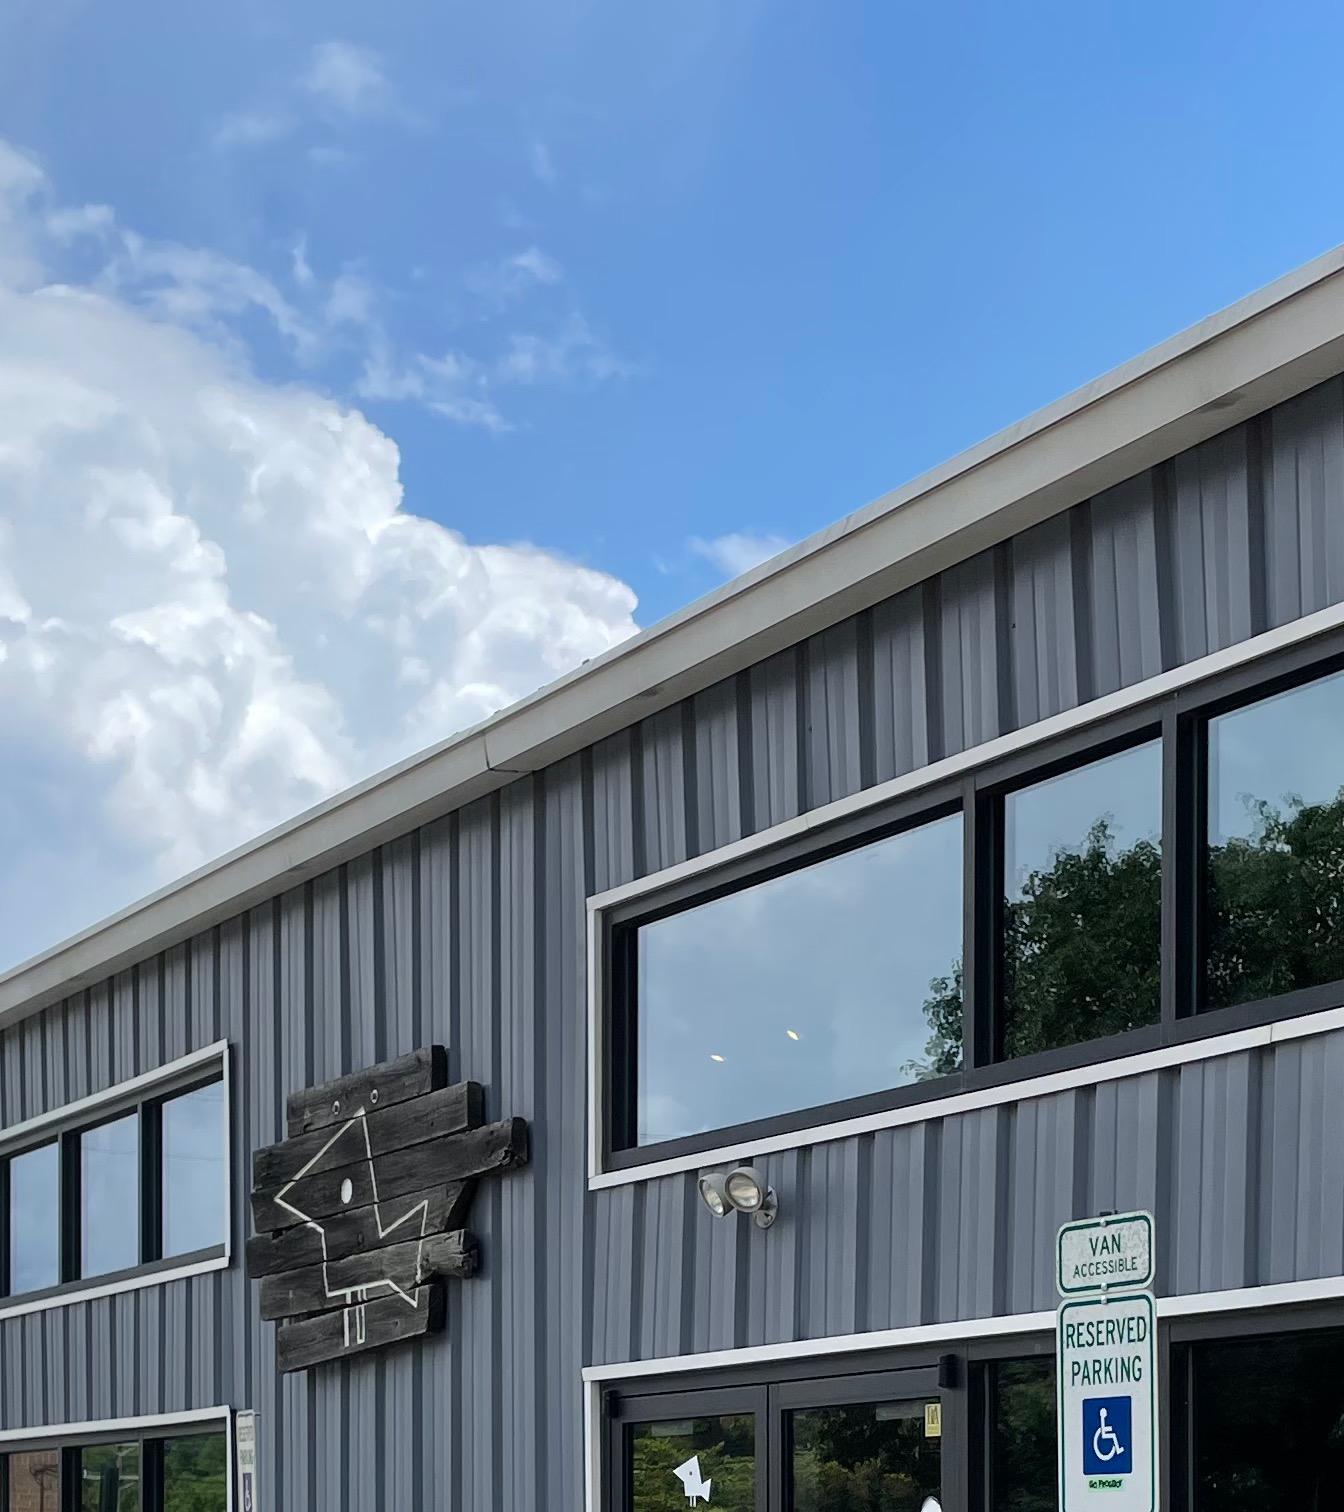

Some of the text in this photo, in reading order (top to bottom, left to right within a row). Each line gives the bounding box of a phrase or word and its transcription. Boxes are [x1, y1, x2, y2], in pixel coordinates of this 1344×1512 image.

[1089, 1233, 1122, 1256] VAN
[1073, 1257, 1138, 1278] ACCESSIBLE
[1066, 1316, 1147, 1349] RESERVED
[1072, 1355, 1142, 1386] PARKING
